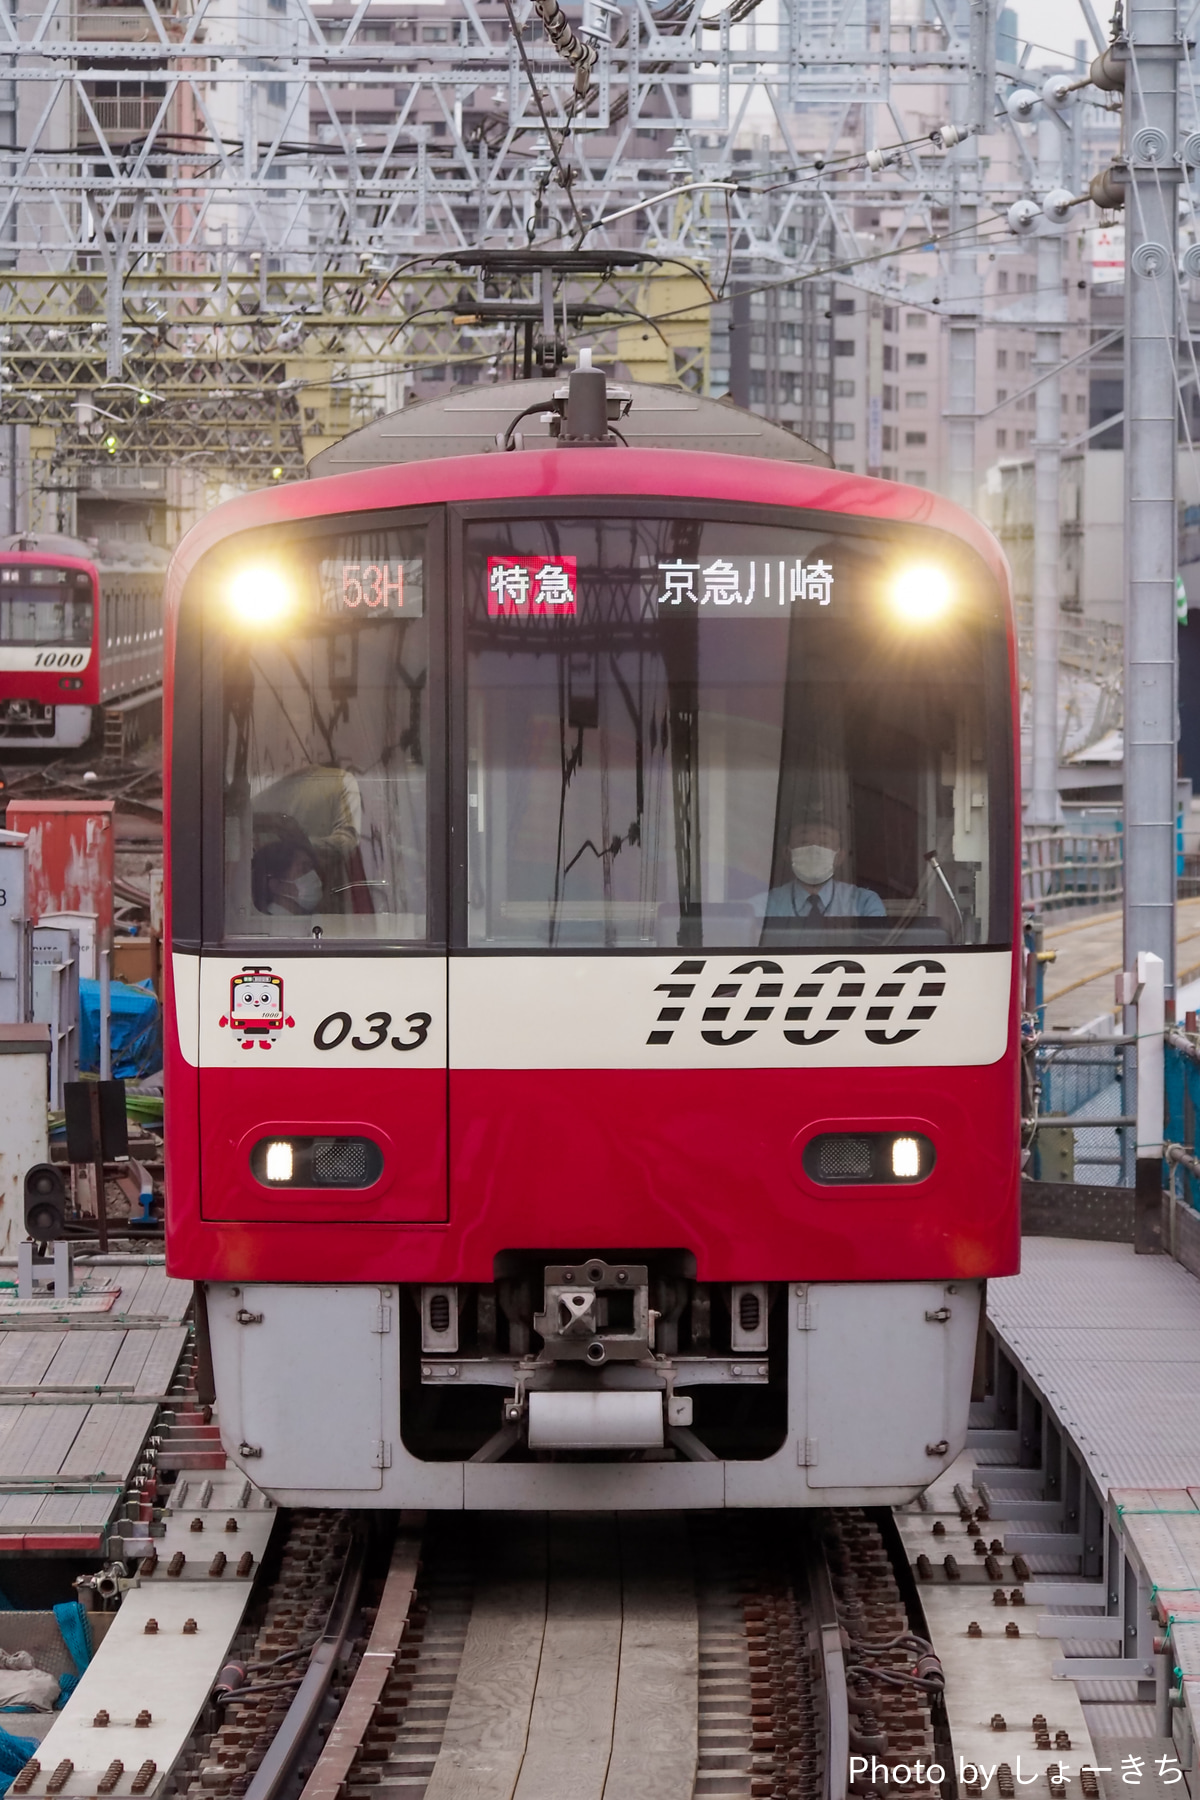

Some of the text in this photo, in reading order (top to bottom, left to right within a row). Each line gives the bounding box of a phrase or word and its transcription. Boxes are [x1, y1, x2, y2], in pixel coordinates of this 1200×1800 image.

[342, 564, 404, 608] 53H
[490, 563, 575, 605] 特急
[657, 558, 835, 606] 京急川崎
[34, 652, 84, 668] 1000
[645, 959, 947, 1046] 1000
[313, 1011, 432, 1051] 033
